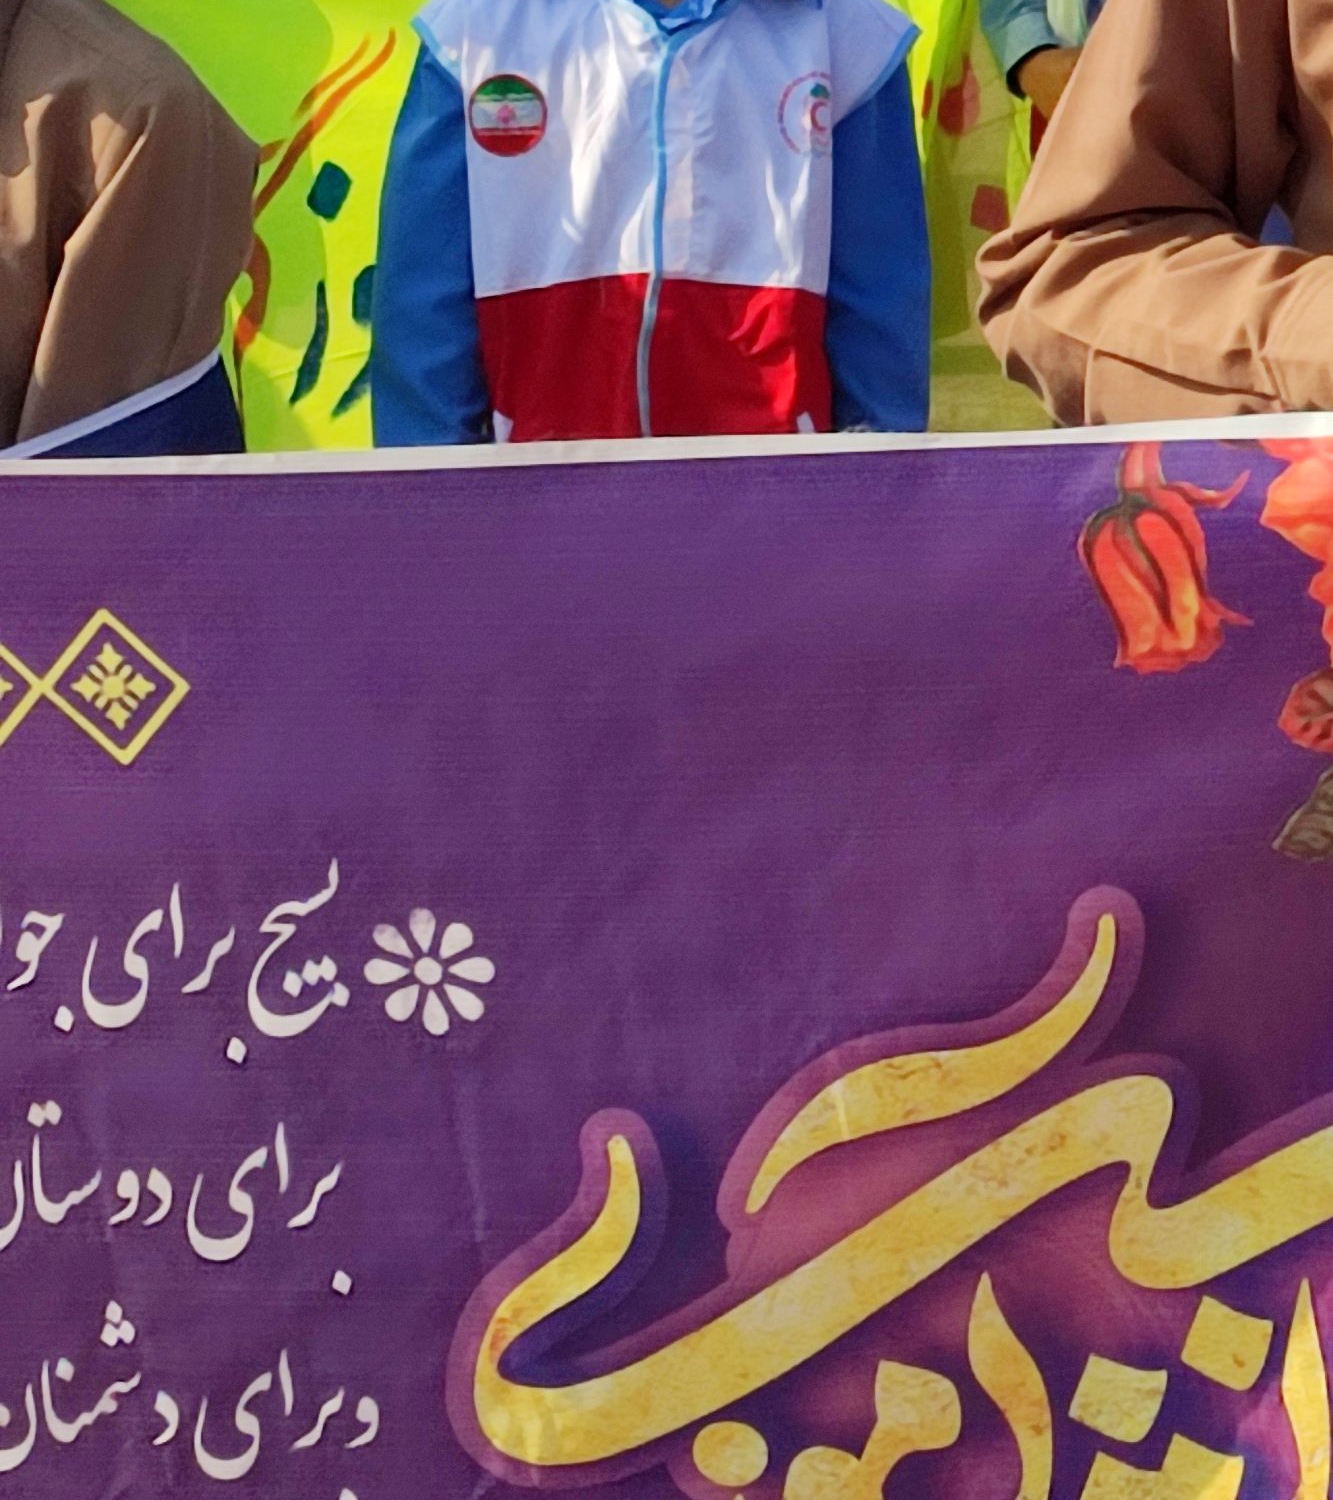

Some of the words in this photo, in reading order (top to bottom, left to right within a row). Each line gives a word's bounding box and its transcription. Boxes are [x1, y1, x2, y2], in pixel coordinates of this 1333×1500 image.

[0, 910, 74, 1032] جو
[81, 882, 247, 1064] برای
[247, 857, 350, 1038] بسیج
[187, 1121, 352, 1296] برای
